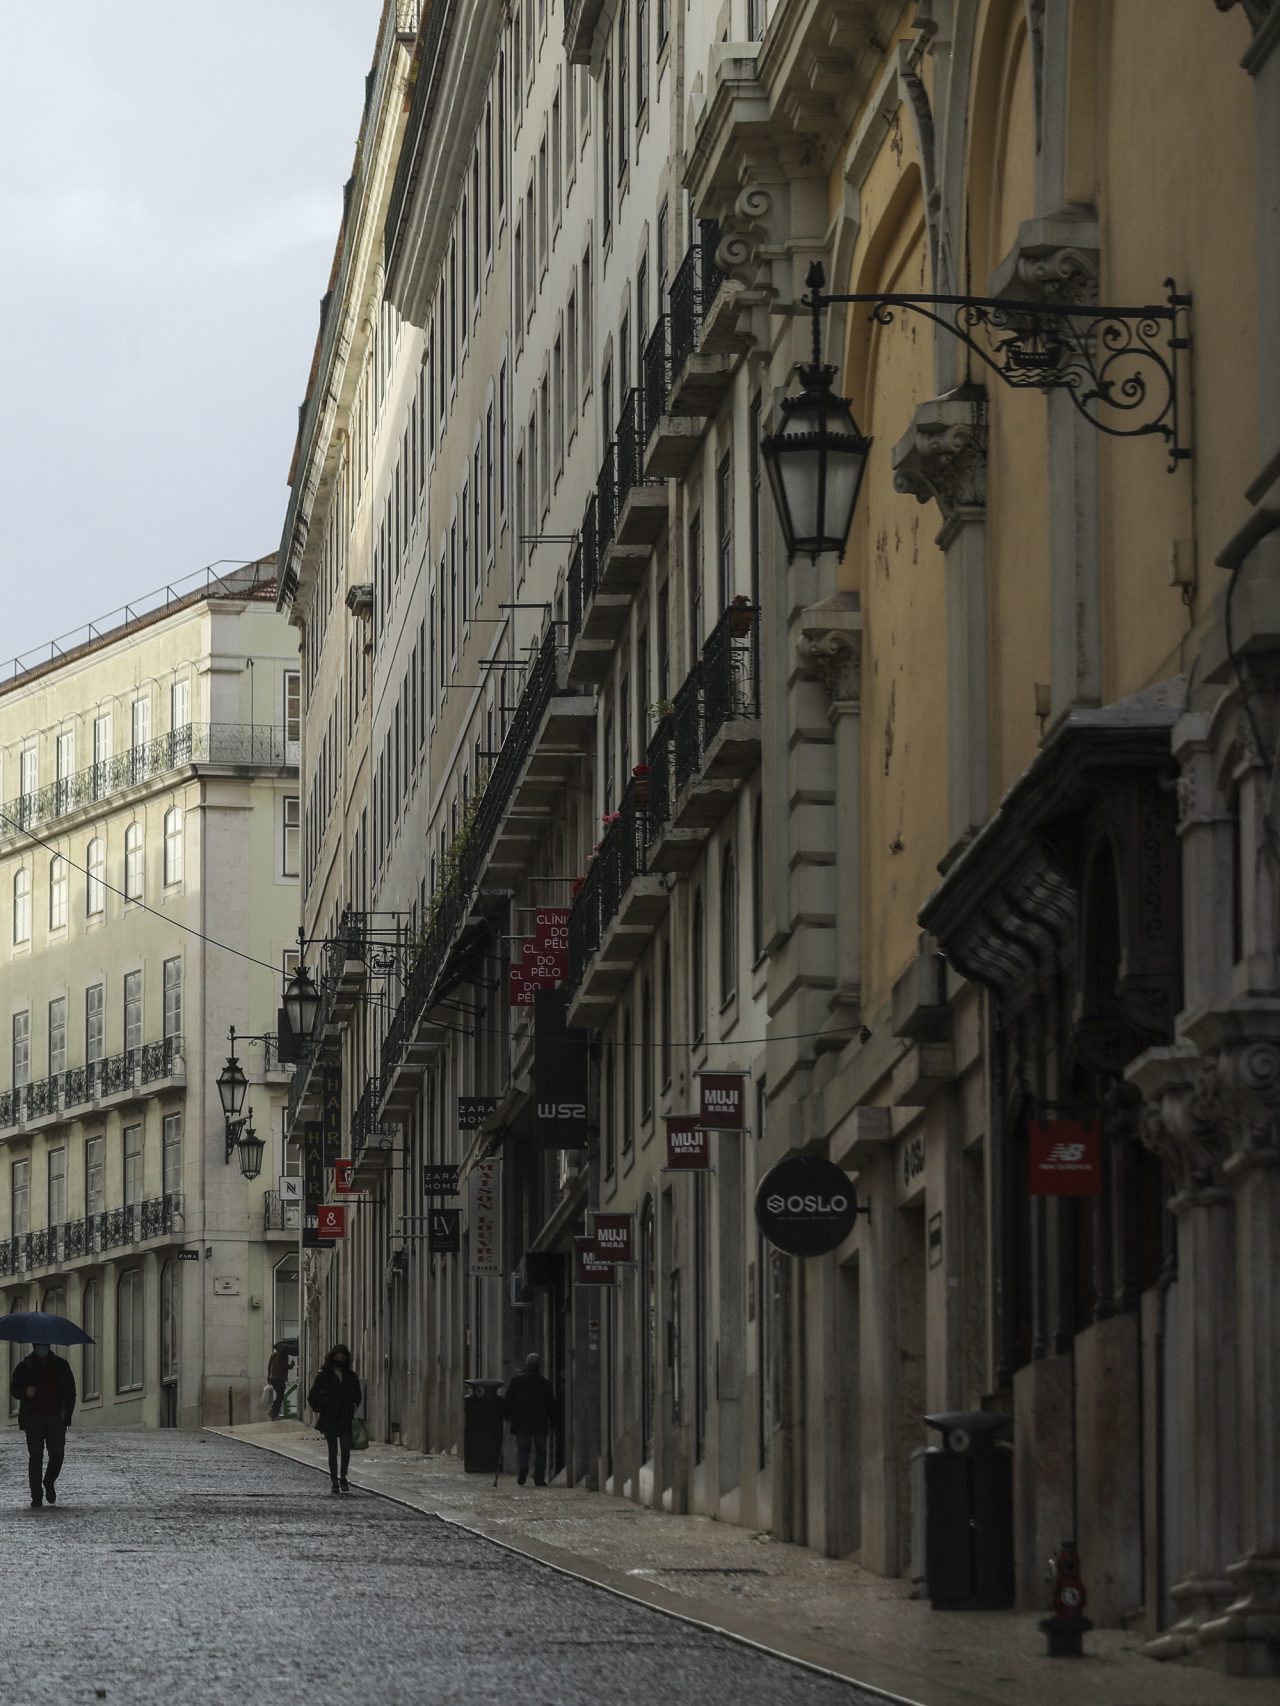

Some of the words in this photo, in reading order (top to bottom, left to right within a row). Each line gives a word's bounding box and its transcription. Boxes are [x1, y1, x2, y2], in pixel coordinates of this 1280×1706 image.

[551, 927, 568, 937] DO
[537, 956, 555, 966] DO
[523, 982, 541, 991] DO
[704, 1090, 739, 1105] MUJI
[327, 1079, 341, 1145] HAIR
[460, 1105, 495, 1113] ZARA
[671, 1132, 704, 1146] MUJI
[308, 1131, 322, 1193] HAIR
[425, 1173, 458, 1181] ZARA
[787, 1195, 848, 1212] OSLO
[598, 1228, 627, 1241] MUJI
